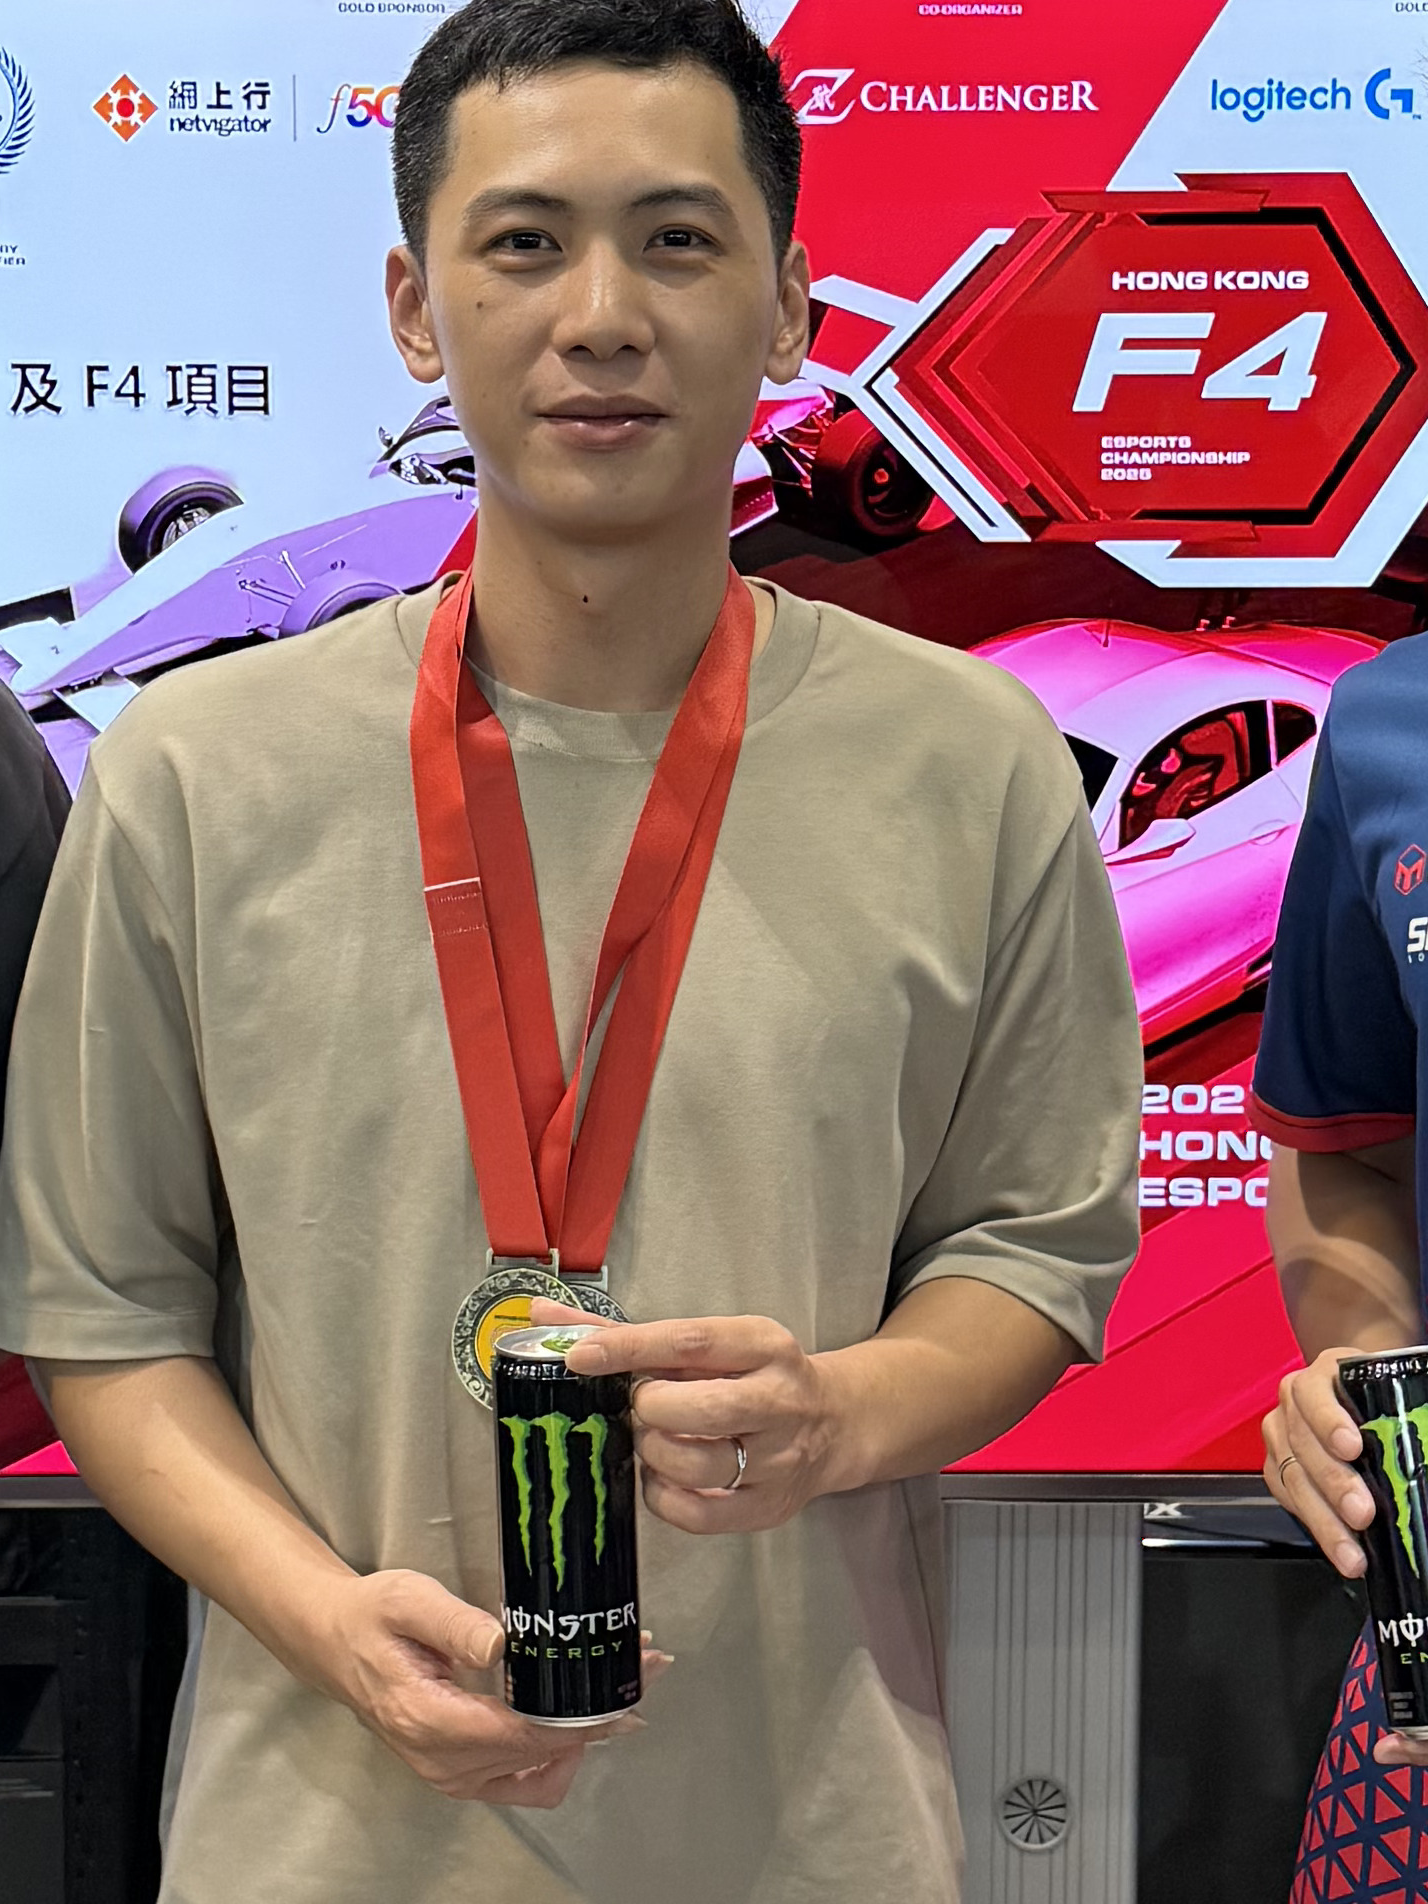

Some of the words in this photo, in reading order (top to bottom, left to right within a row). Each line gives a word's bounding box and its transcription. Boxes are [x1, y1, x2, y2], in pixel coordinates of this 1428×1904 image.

[168, 81, 271, 111] 網上行
[859, 80, 1100, 112] CHALLENGER
[1211, 77, 1352, 123] logitech
[169, 114, 272, 136] netvigator
[1112, 271, 1209, 291] HONG
[1214, 270, 1310, 291] KONG
[1072, 311, 1329, 413] F4
[9, 362, 64, 417] 及
[86, 364, 147, 409] F4
[166, 364, 272, 418] 項目
[1100, 451, 1251, 465] CHAMPIONSHIP
[1142, 1083, 1253, 1114] 202
[511, 1640, 622, 1659] ENERGY
